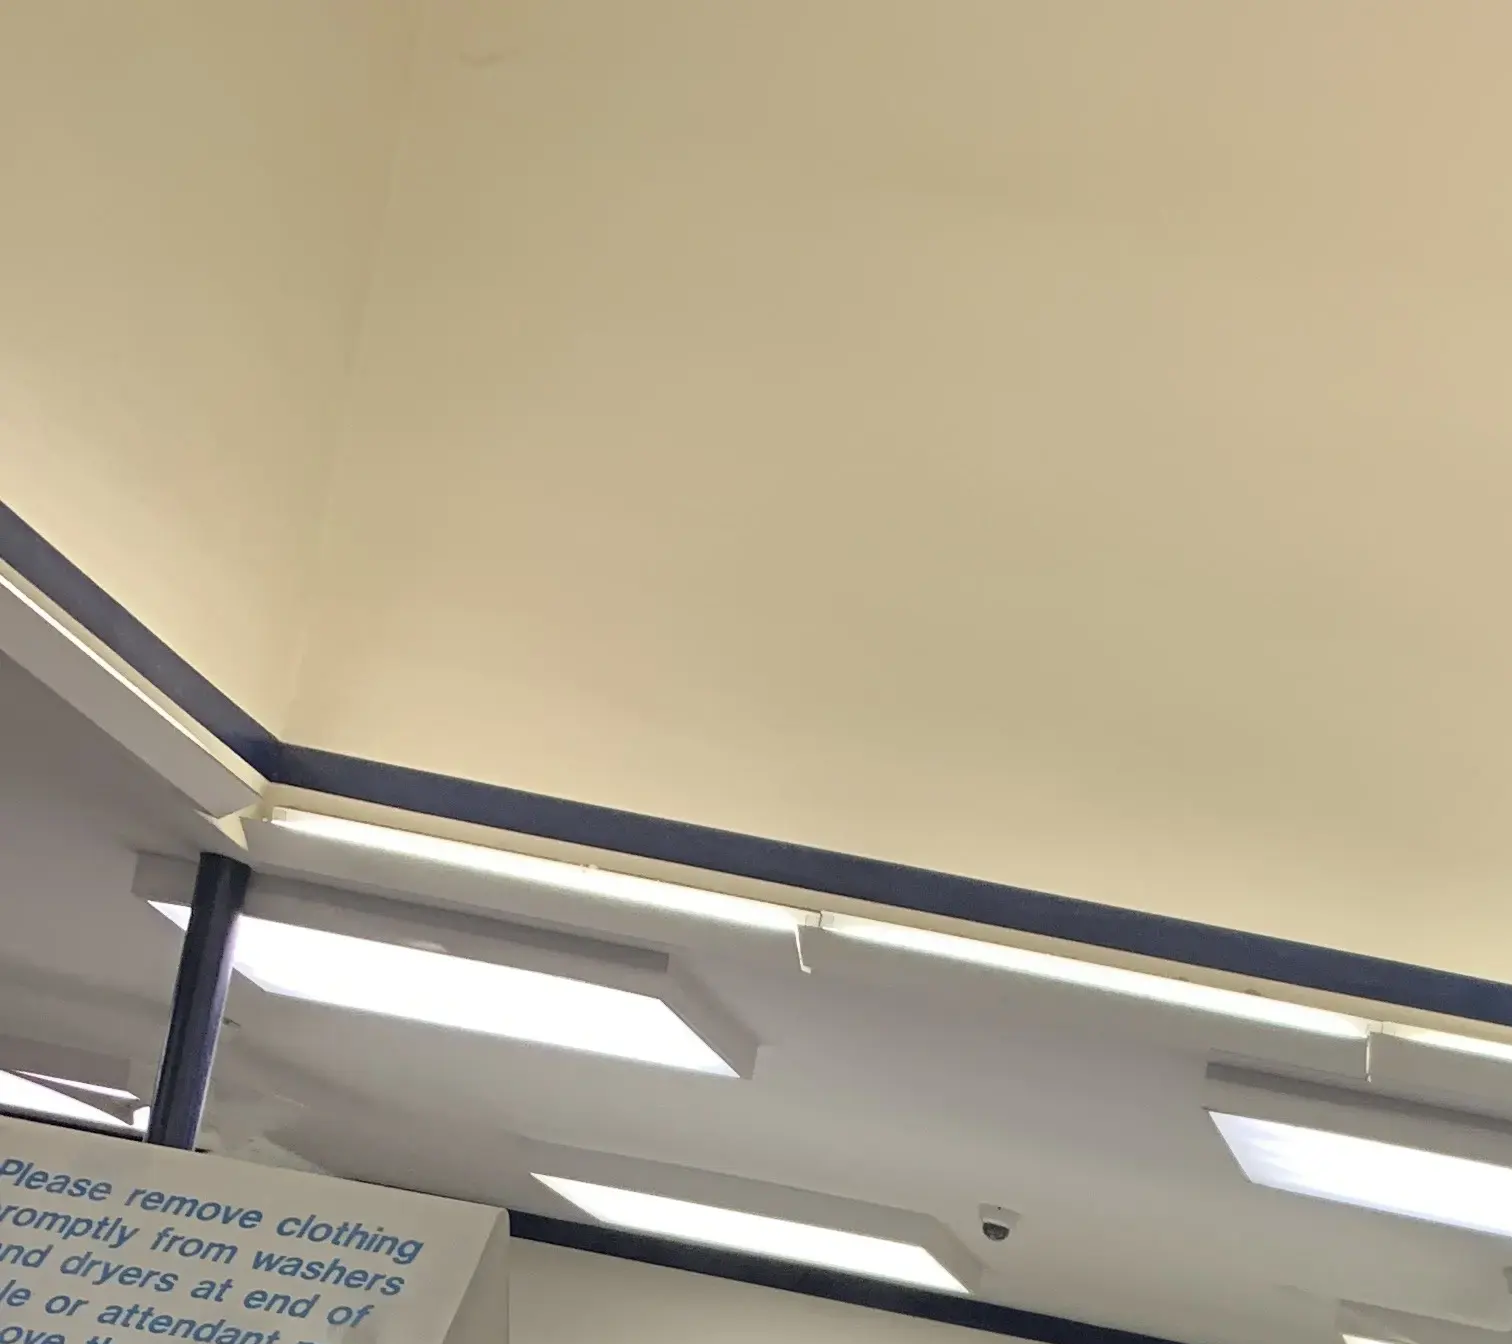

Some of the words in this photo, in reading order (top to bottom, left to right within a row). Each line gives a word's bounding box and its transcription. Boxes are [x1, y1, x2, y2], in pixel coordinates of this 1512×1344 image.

[0, 1159, 112, 1200] Please
[125, 1189, 262, 1228] remove
[277, 1214, 424, 1264] clothing
[0, 1206, 140, 1248] romptly
[150, 1227, 238, 1264] from
[252, 1251, 404, 1296] washers
[0, 1243, 52, 1268] nd
[60, 1252, 178, 1292] dryers
[191, 1279, 232, 1302] at
[244, 1290, 319, 1318] end
[327, 1305, 373, 1328] of
[45, 1296, 89, 1316] or
